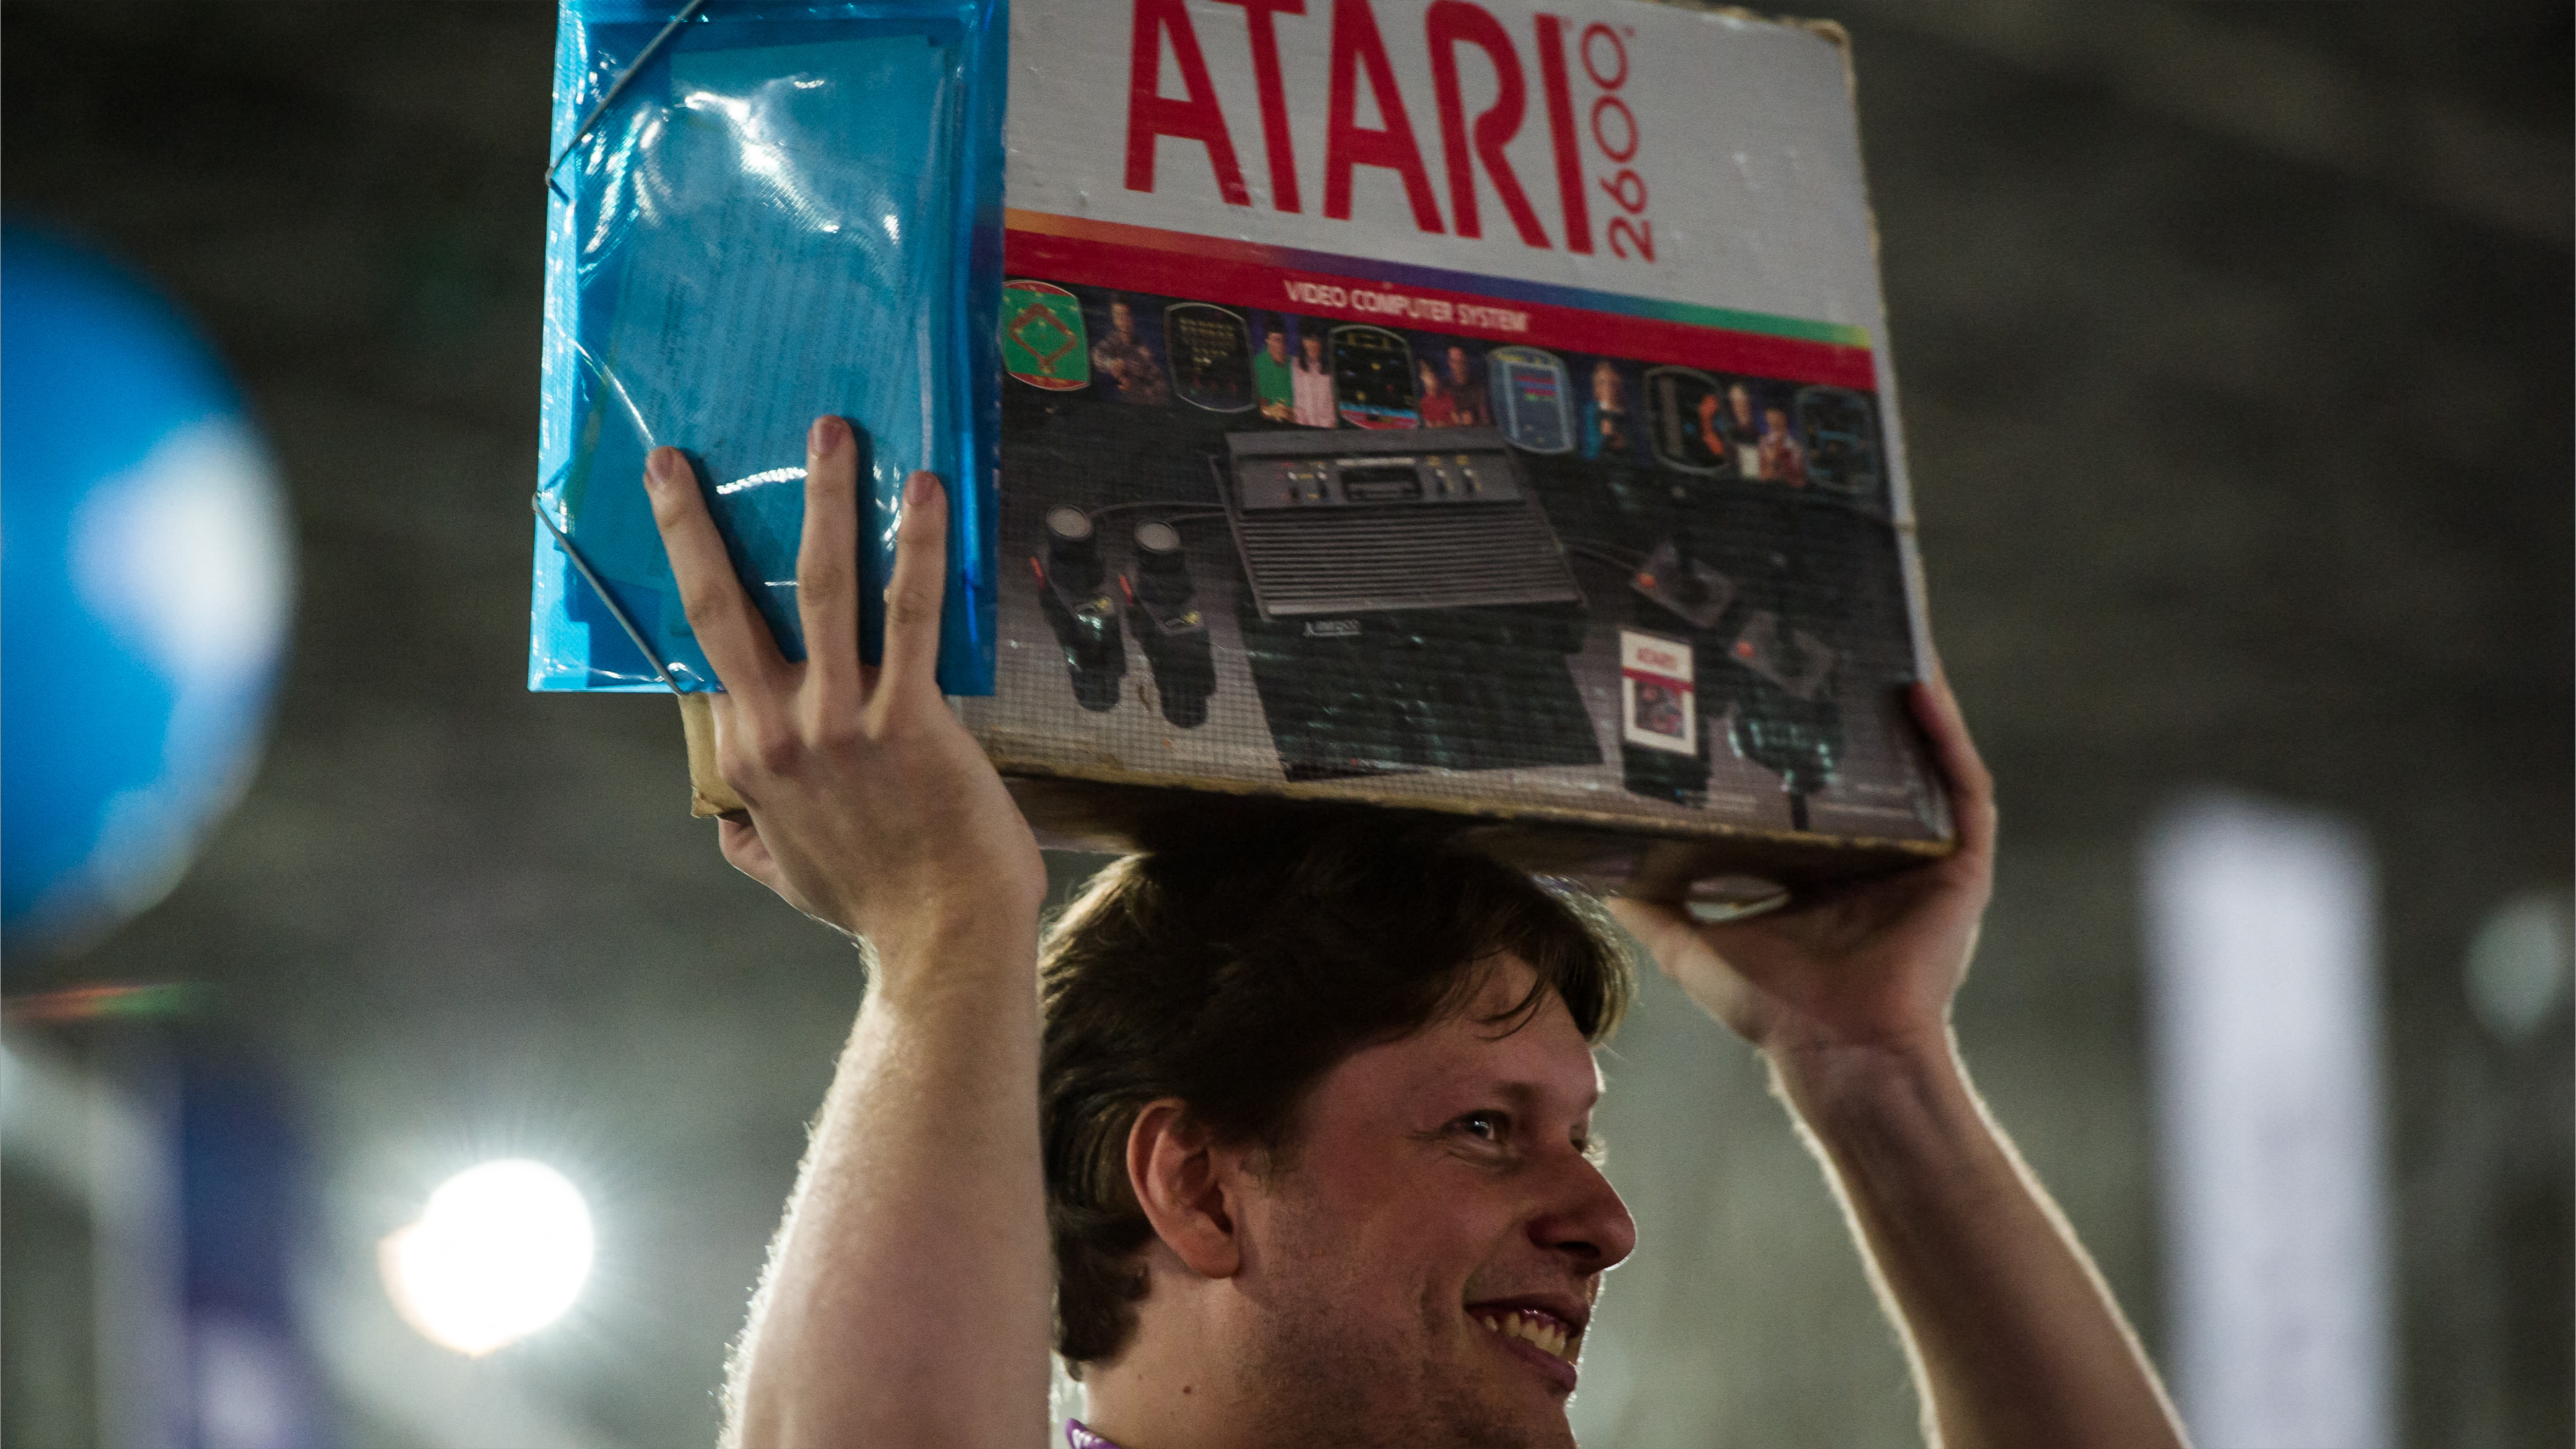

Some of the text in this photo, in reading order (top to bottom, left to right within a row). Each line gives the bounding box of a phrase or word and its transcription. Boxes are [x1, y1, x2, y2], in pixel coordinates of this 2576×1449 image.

[1124, 0, 1595, 256] ATARI
[1579, 21, 1656, 264] 2600
[1283, 279, 1529, 331] VIDEO COMPUTER SYSTEM
